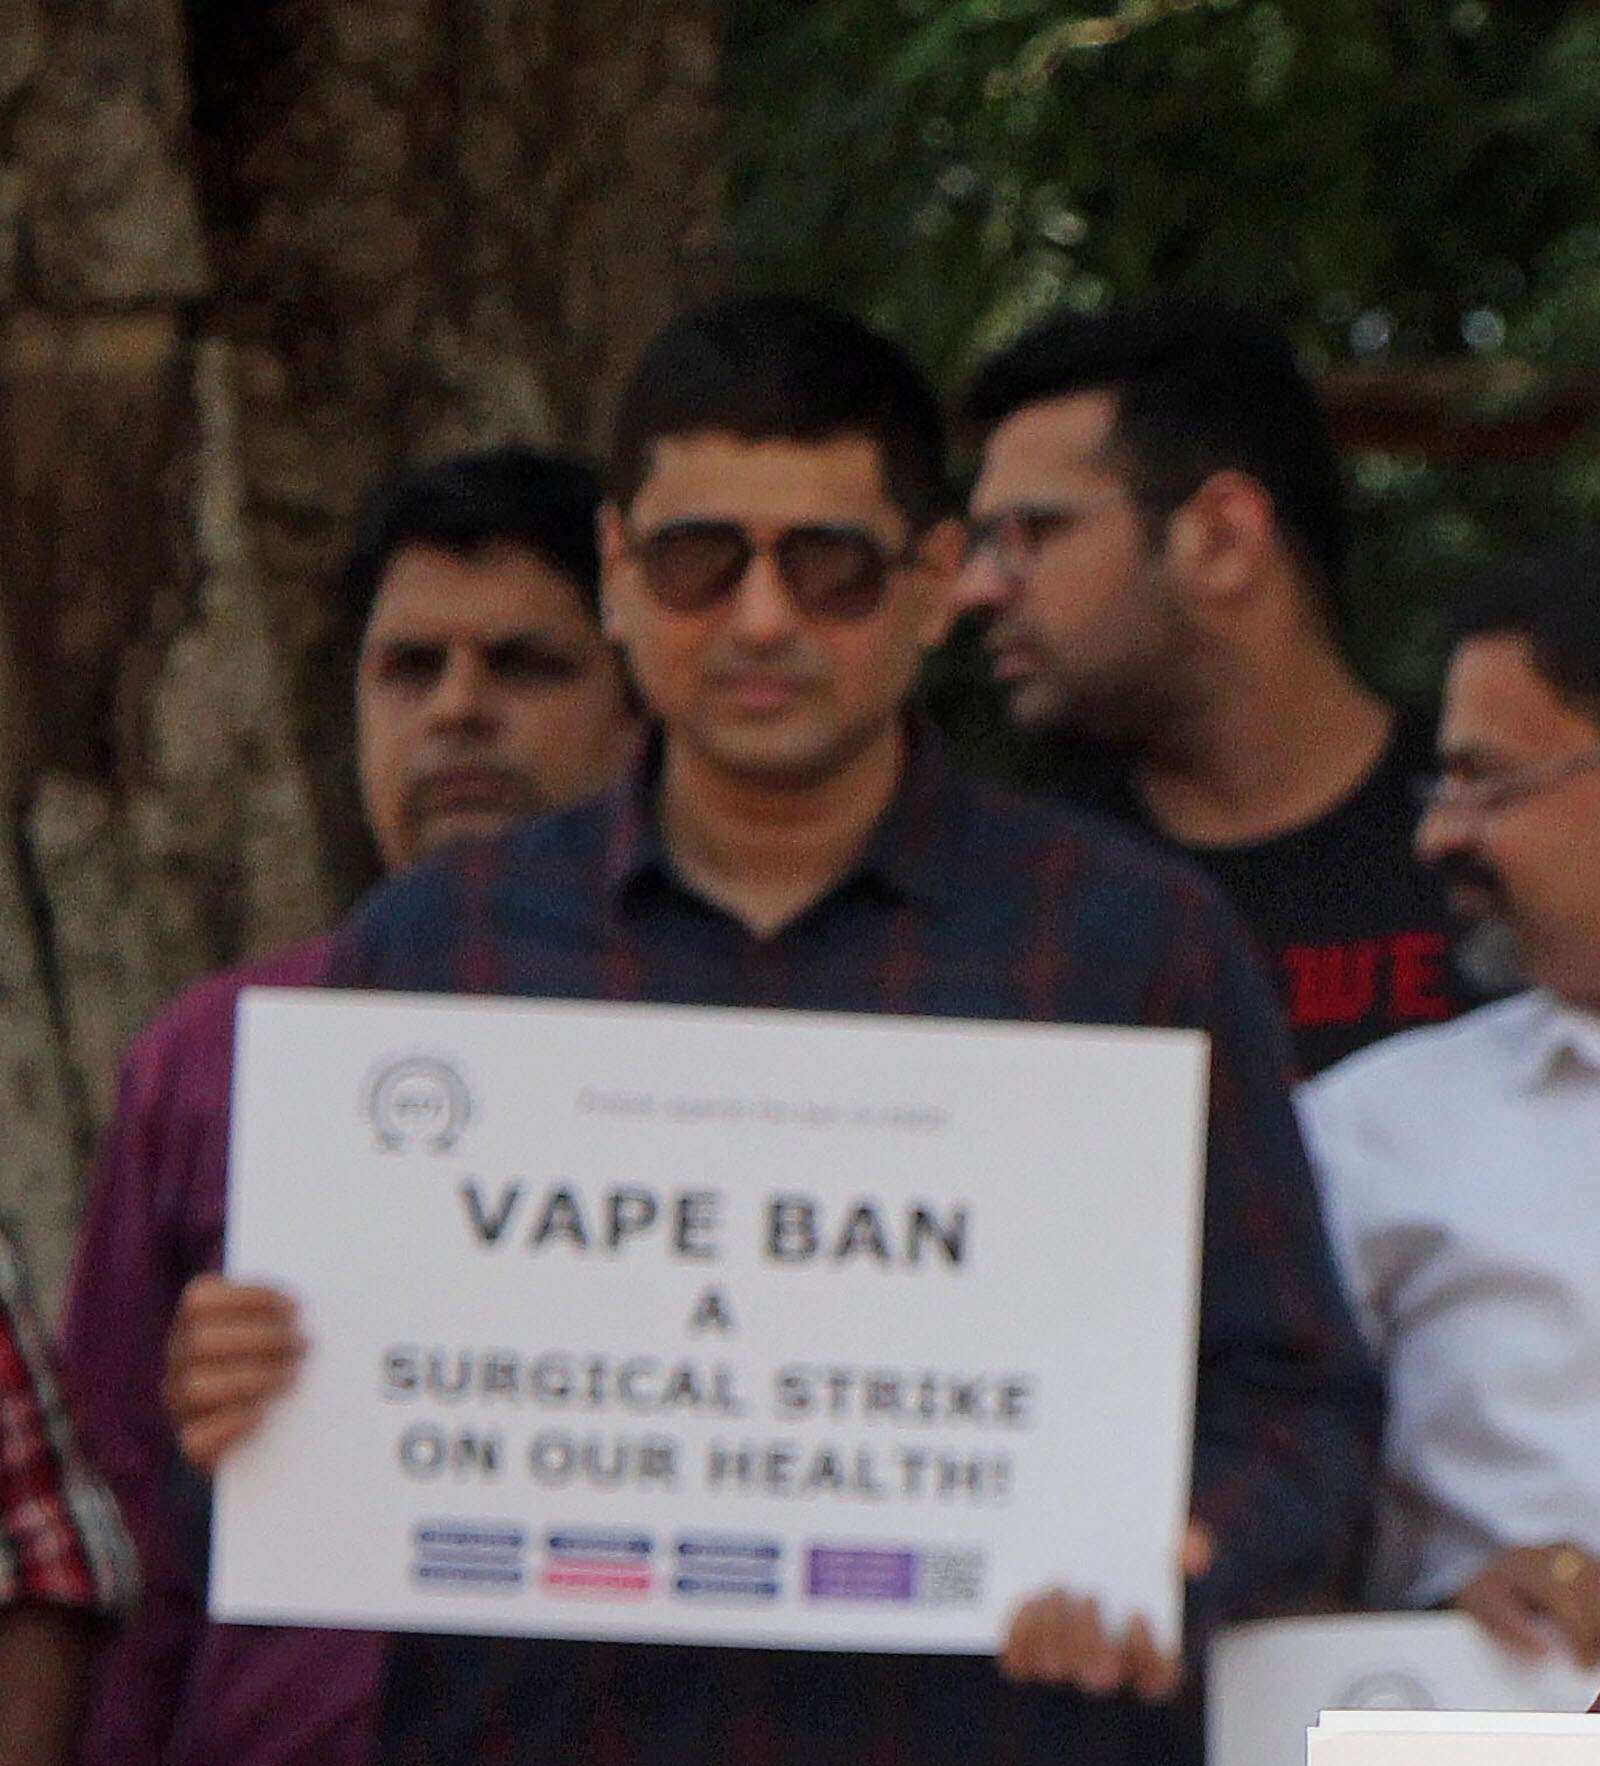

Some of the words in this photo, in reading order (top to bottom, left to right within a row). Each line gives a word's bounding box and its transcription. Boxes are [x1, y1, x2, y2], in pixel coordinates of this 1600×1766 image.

[460, 1181, 716, 1260] VAPE
[763, 1194, 969, 1270] BAN
[690, 1288, 733, 1332] A
[380, 1345, 742, 1425] SURGICAL
[773, 1366, 1031, 1427] STRIKE
[398, 1428, 502, 1478] ON
[527, 1430, 678, 1487] OUR
[706, 1446, 1009, 1499] HEALTH!
